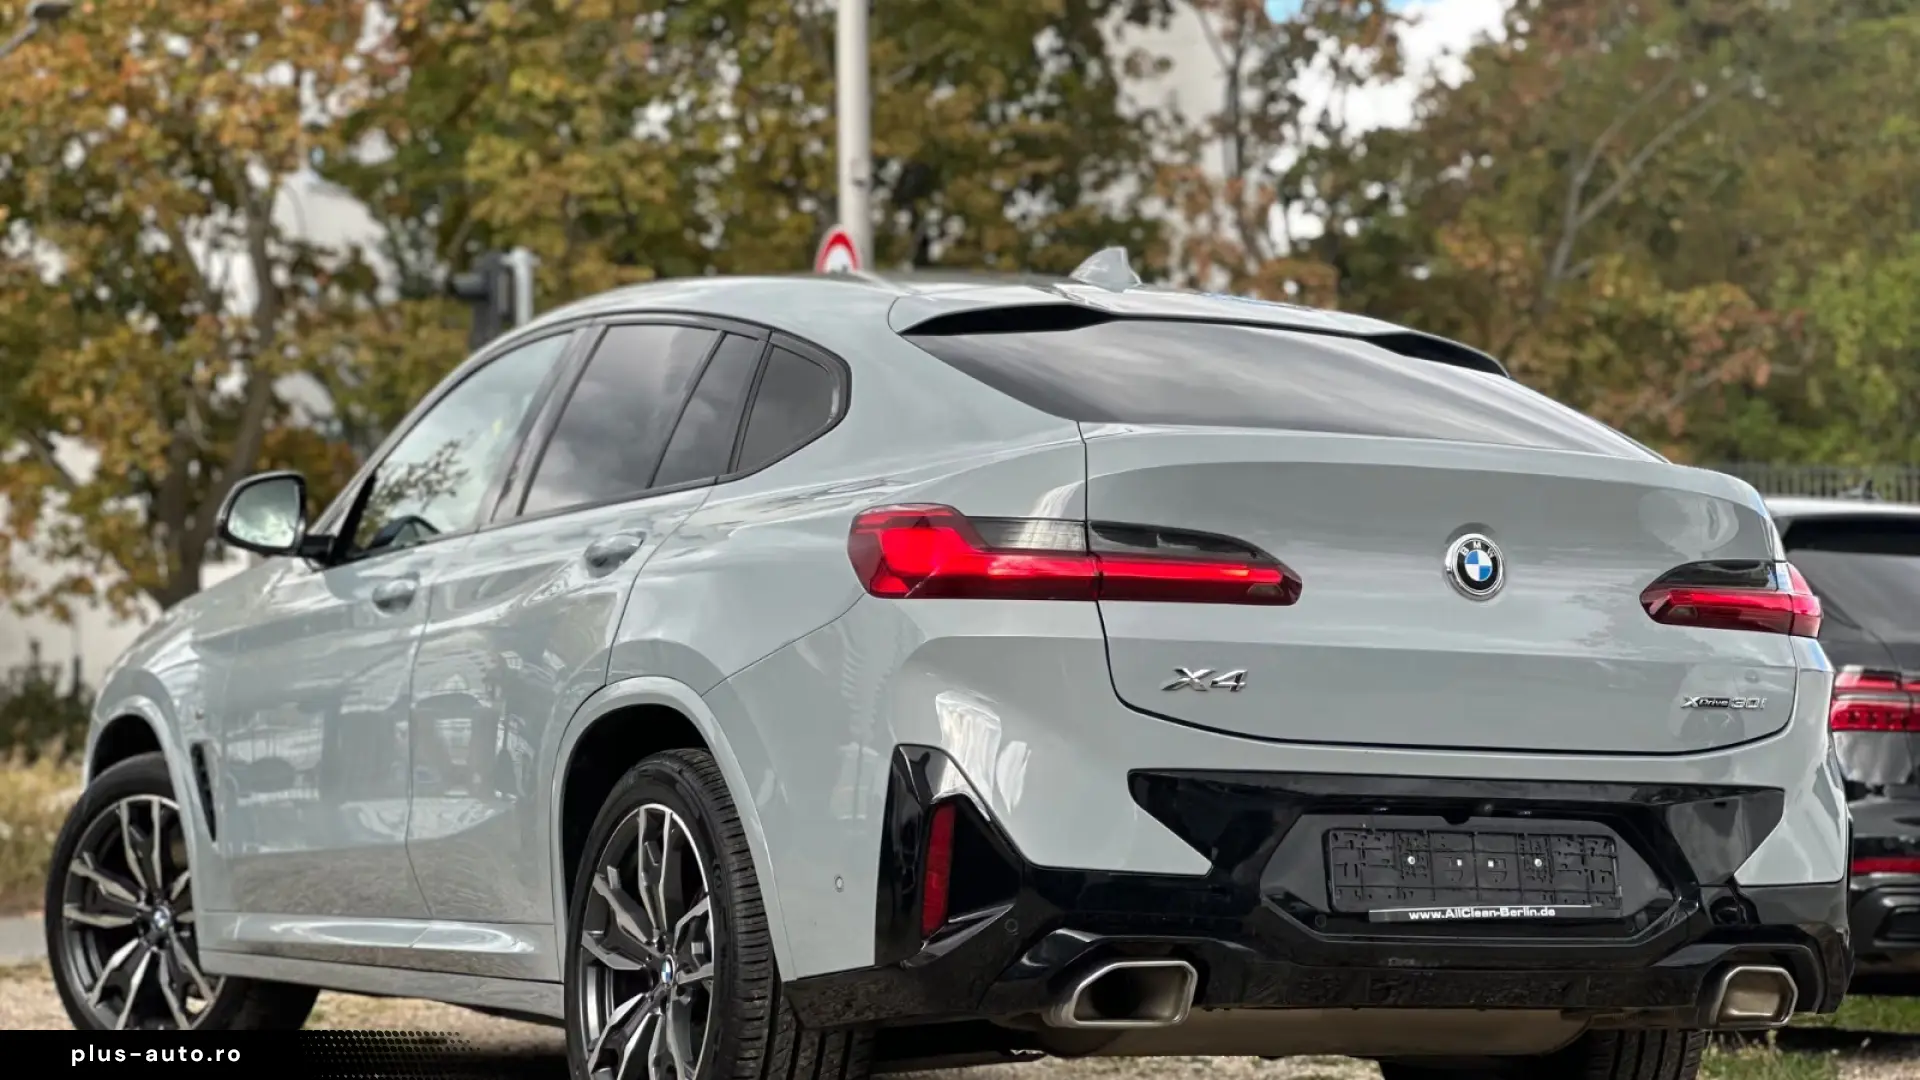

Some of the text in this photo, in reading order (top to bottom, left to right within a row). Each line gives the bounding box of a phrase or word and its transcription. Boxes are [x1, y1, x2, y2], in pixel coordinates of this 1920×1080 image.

[1460, 541, 1497, 558] BMW
[1161, 667, 1248, 692] X4
[1409, 906, 1556, 920] www.AllClean-Berlin.de
